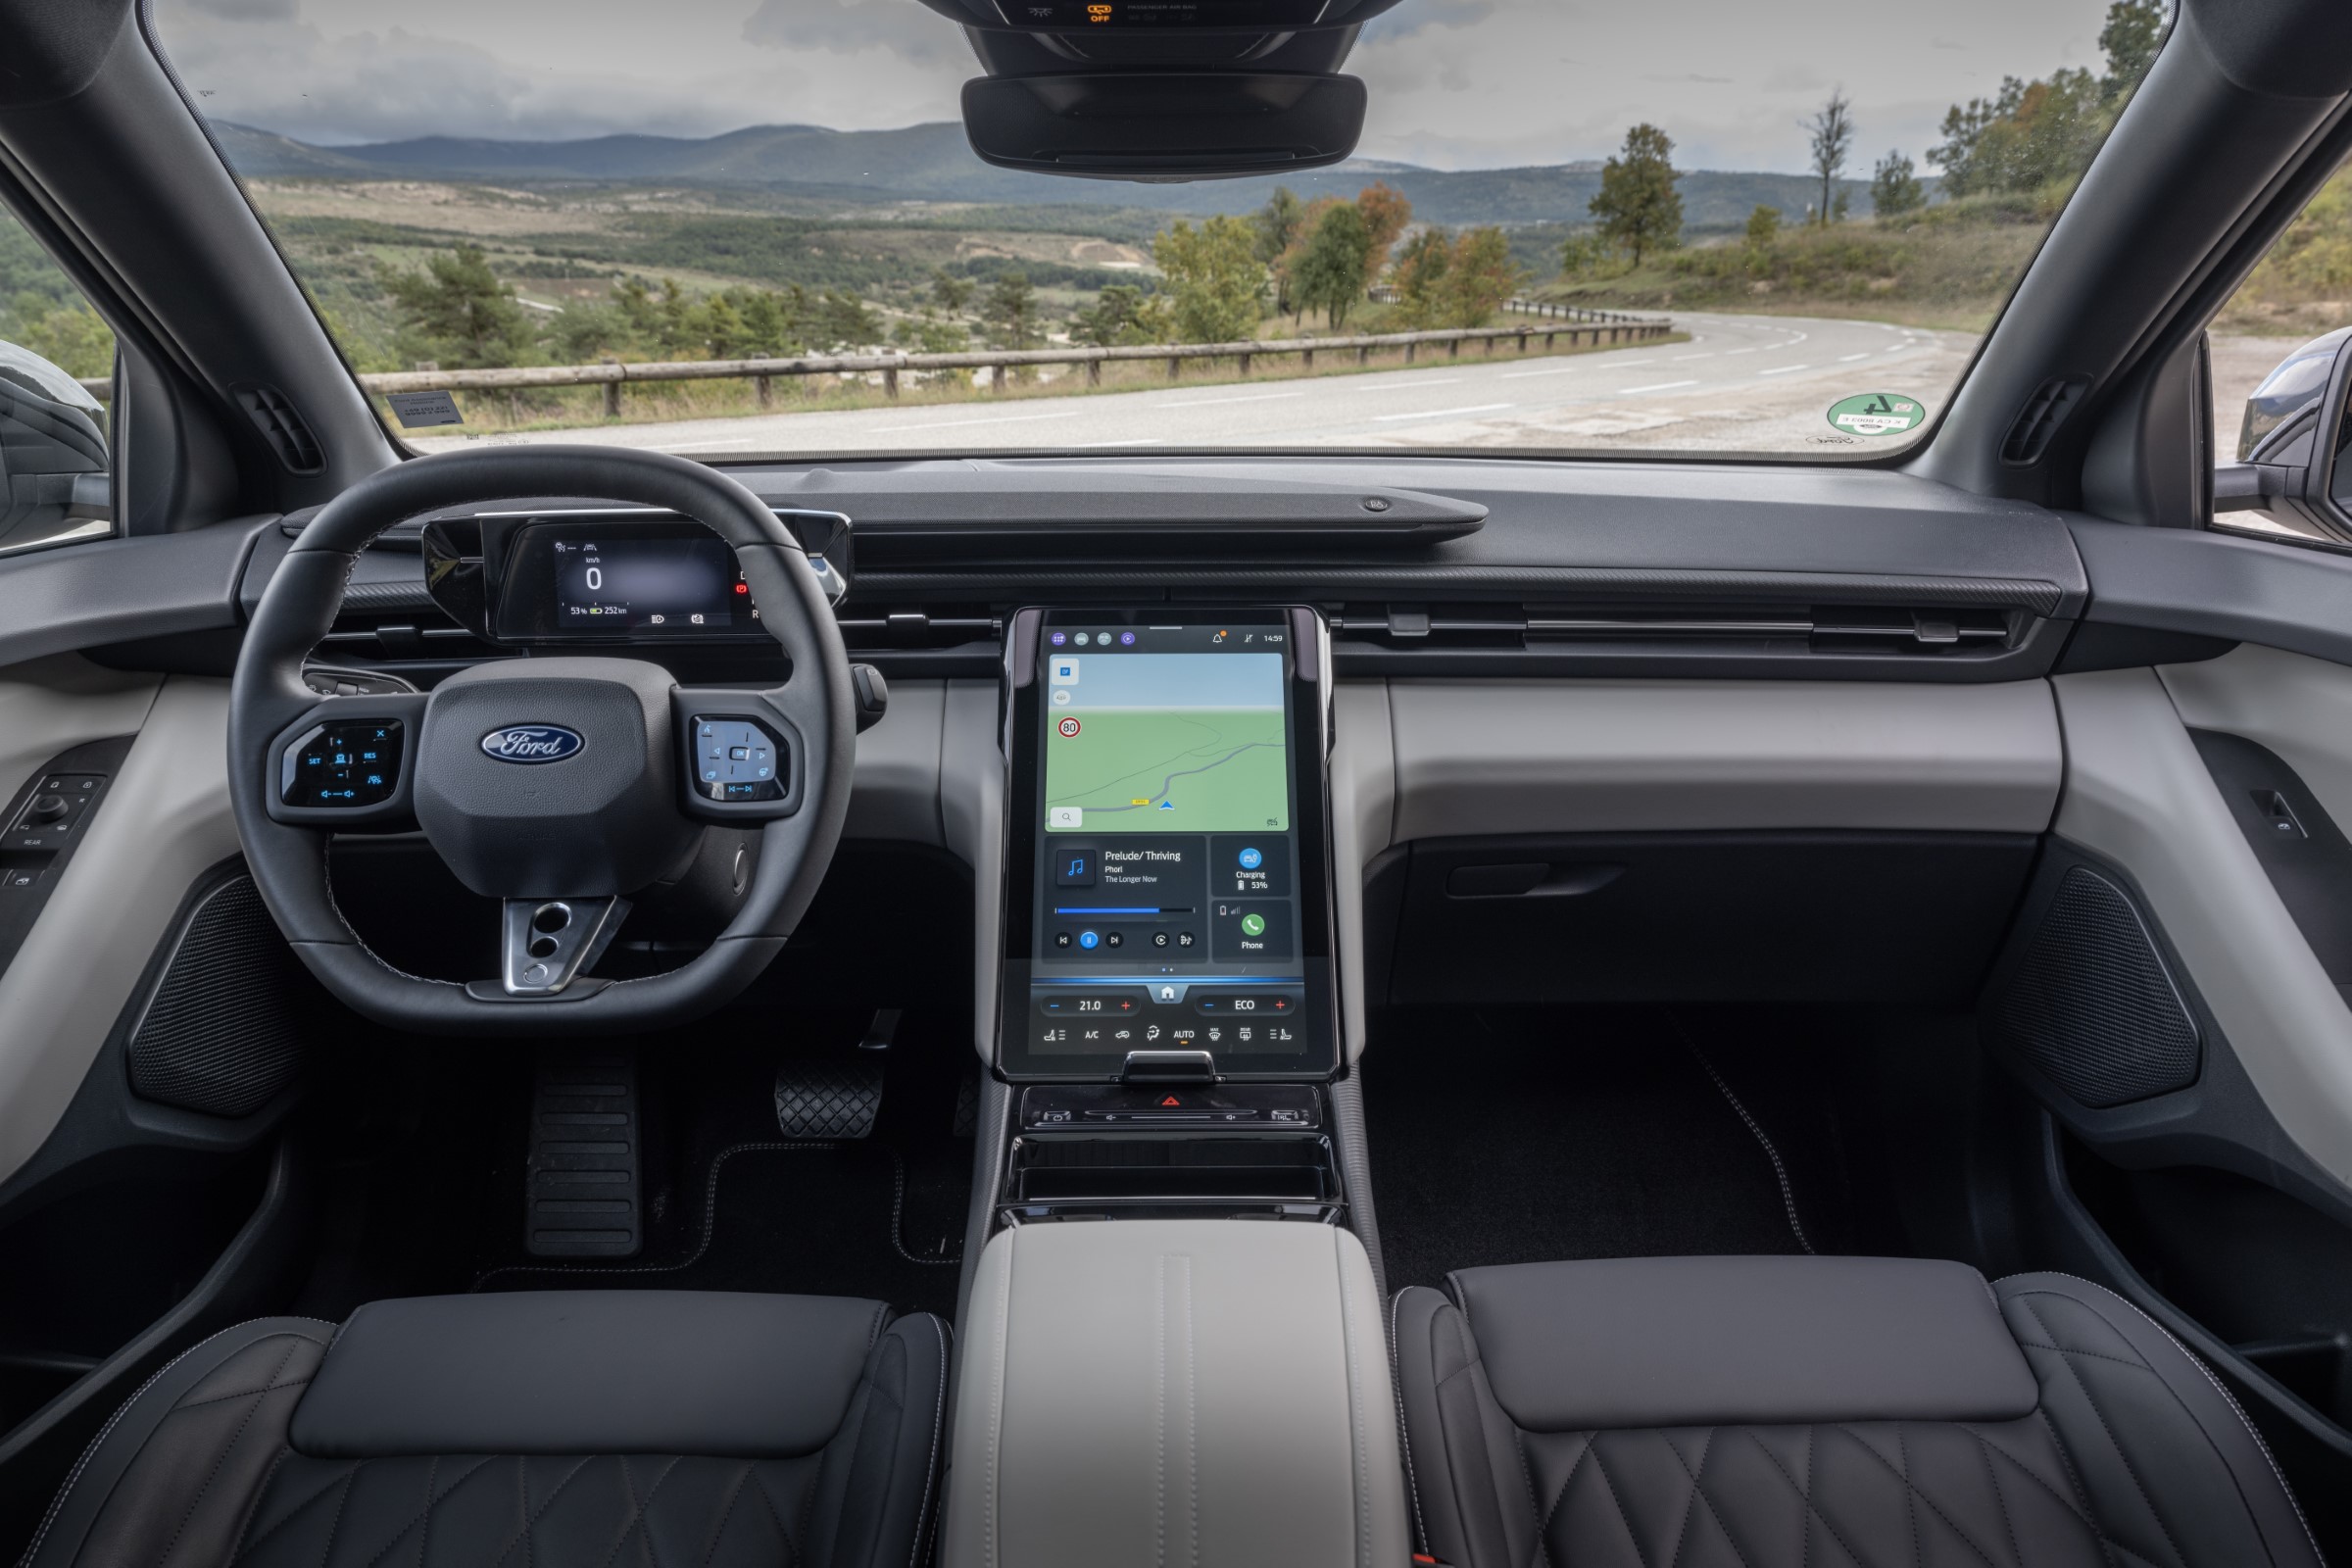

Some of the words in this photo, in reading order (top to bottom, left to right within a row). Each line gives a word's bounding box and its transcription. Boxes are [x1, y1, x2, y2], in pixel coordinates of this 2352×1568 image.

[586, 566, 602, 590] 0
[570, 607, 581, 615] 53
[604, 606, 618, 615] 252
[752, 609, 760, 619] R
[1263, 634, 1283, 643] 14:59
[1063, 722, 1076, 733] 80
[500, 730, 564, 756] Ford
[1104, 851, 1145, 861] Prelude/
[1145, 851, 1182, 862] Thriving
[1118, 875, 1142, 884] Longer
[1236, 870, 1266, 881] Charging
[1241, 941, 1263, 950] Phone
[1079, 1001, 1102, 1011] 21.0
[1235, 1000, 1255, 1010] ECO
[1085, 1030, 1099, 1040] A/C
[1173, 1030, 1195, 1039] AUTO
